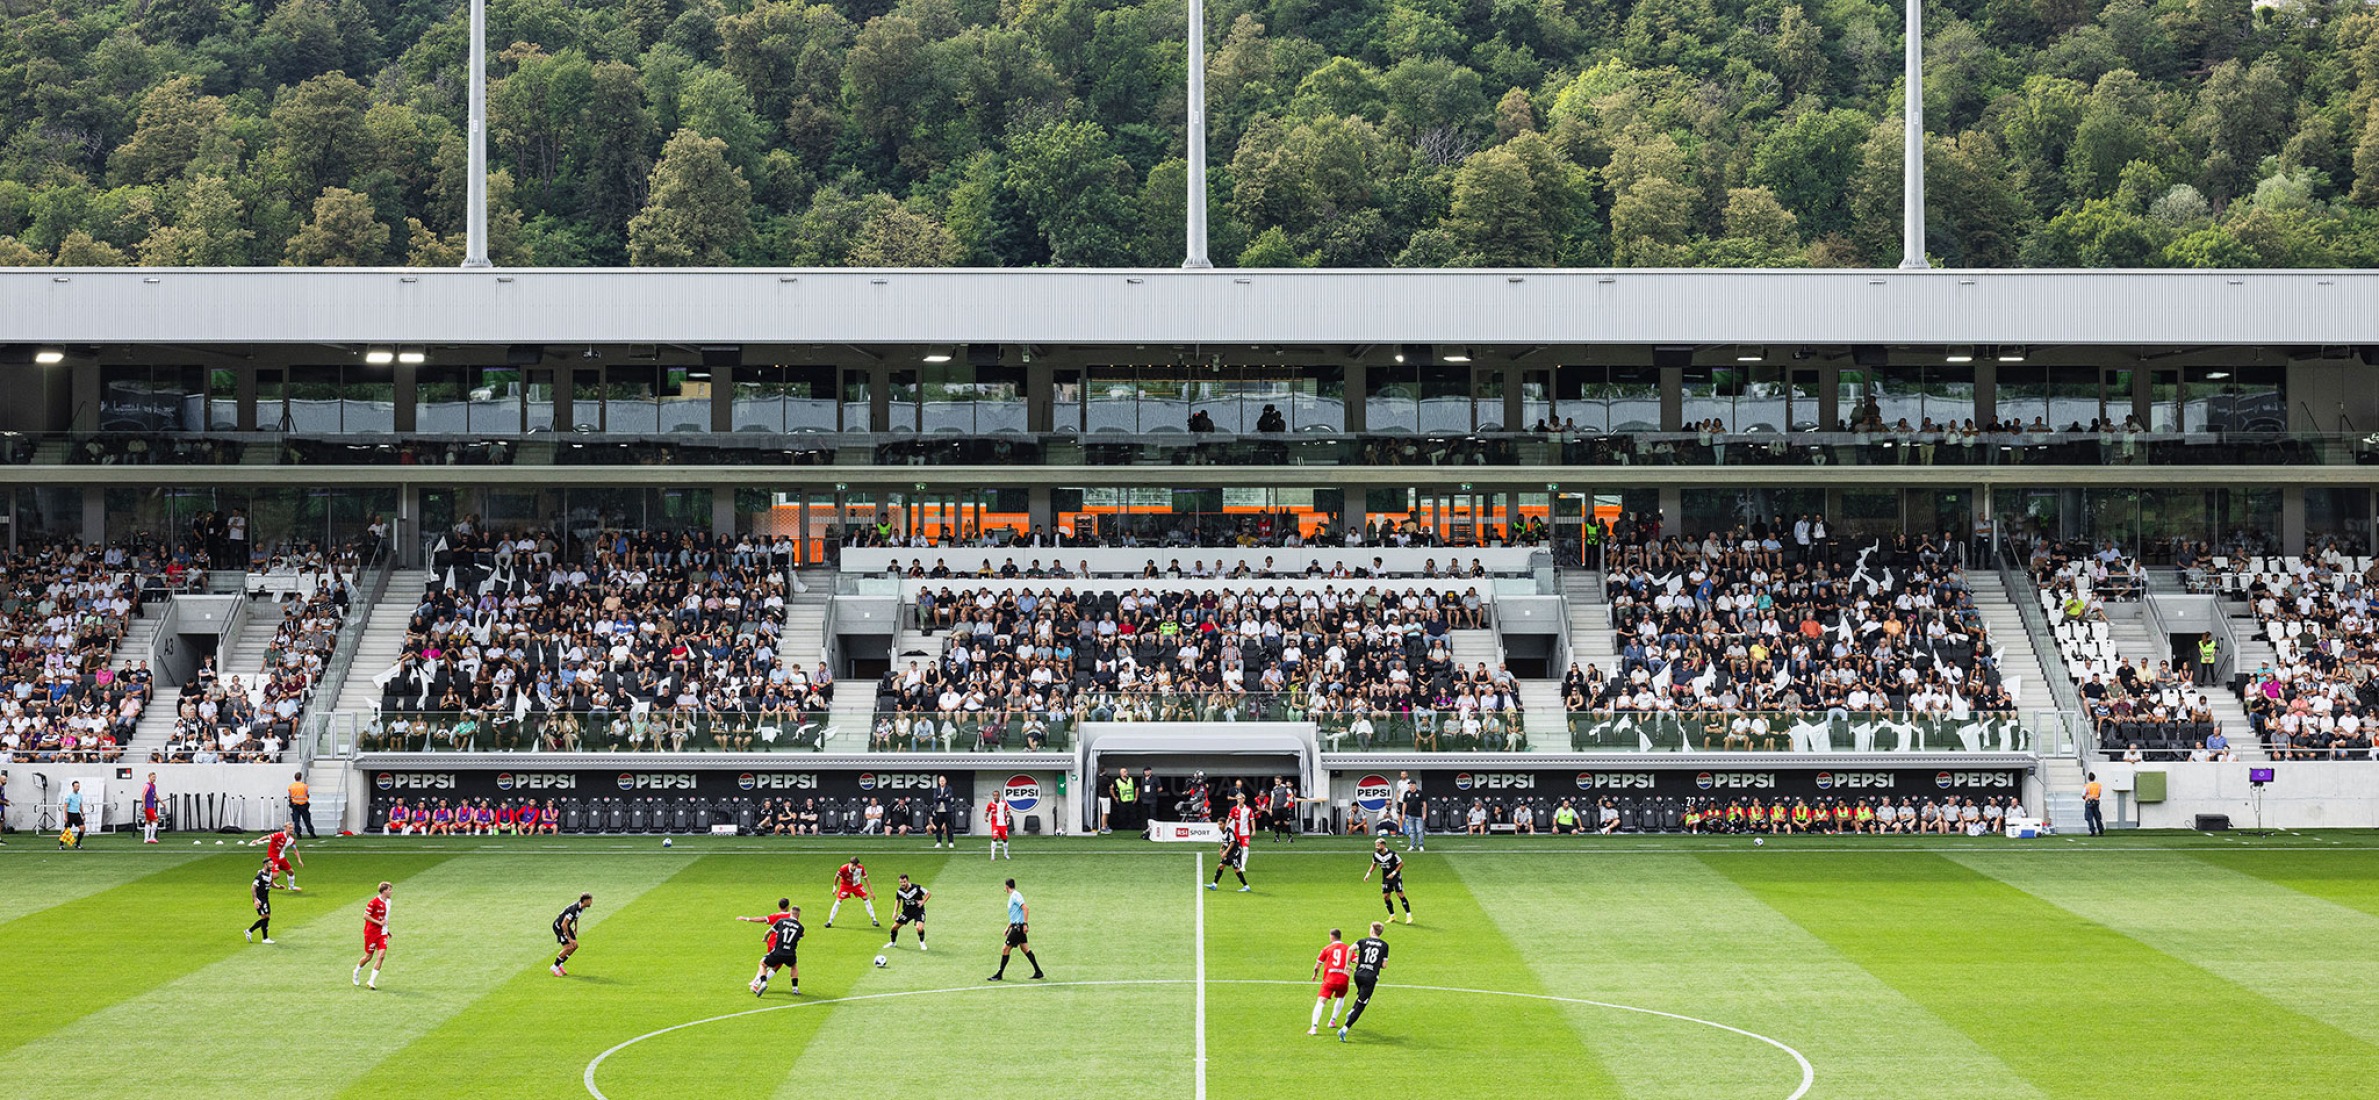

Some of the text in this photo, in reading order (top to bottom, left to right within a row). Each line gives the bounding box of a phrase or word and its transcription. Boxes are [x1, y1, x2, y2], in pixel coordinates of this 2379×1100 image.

[164, 637, 174, 656] A3
[394, 774, 455, 790] PEPSI
[515, 774, 576, 790] PEPSI
[635, 774, 696, 790] PEPSI
[756, 774, 817, 790] PEPSI
[877, 774, 938, 790] PEPSI
[1474, 774, 1535, 789] PEPSI
[1594, 774, 1655, 789] PEPSI
[1714, 774, 1775, 789] PEPSI
[1834, 773, 1895, 788] PEPSI
[1953, 773, 2014, 788] PEPSI
[1005, 788, 1039, 797] PEPSI
[1357, 788, 1391, 797] PEPSI
[782, 927, 797, 943] 17
[1332, 948, 1342, 967] 9
[1364, 946, 1380, 964] 18
